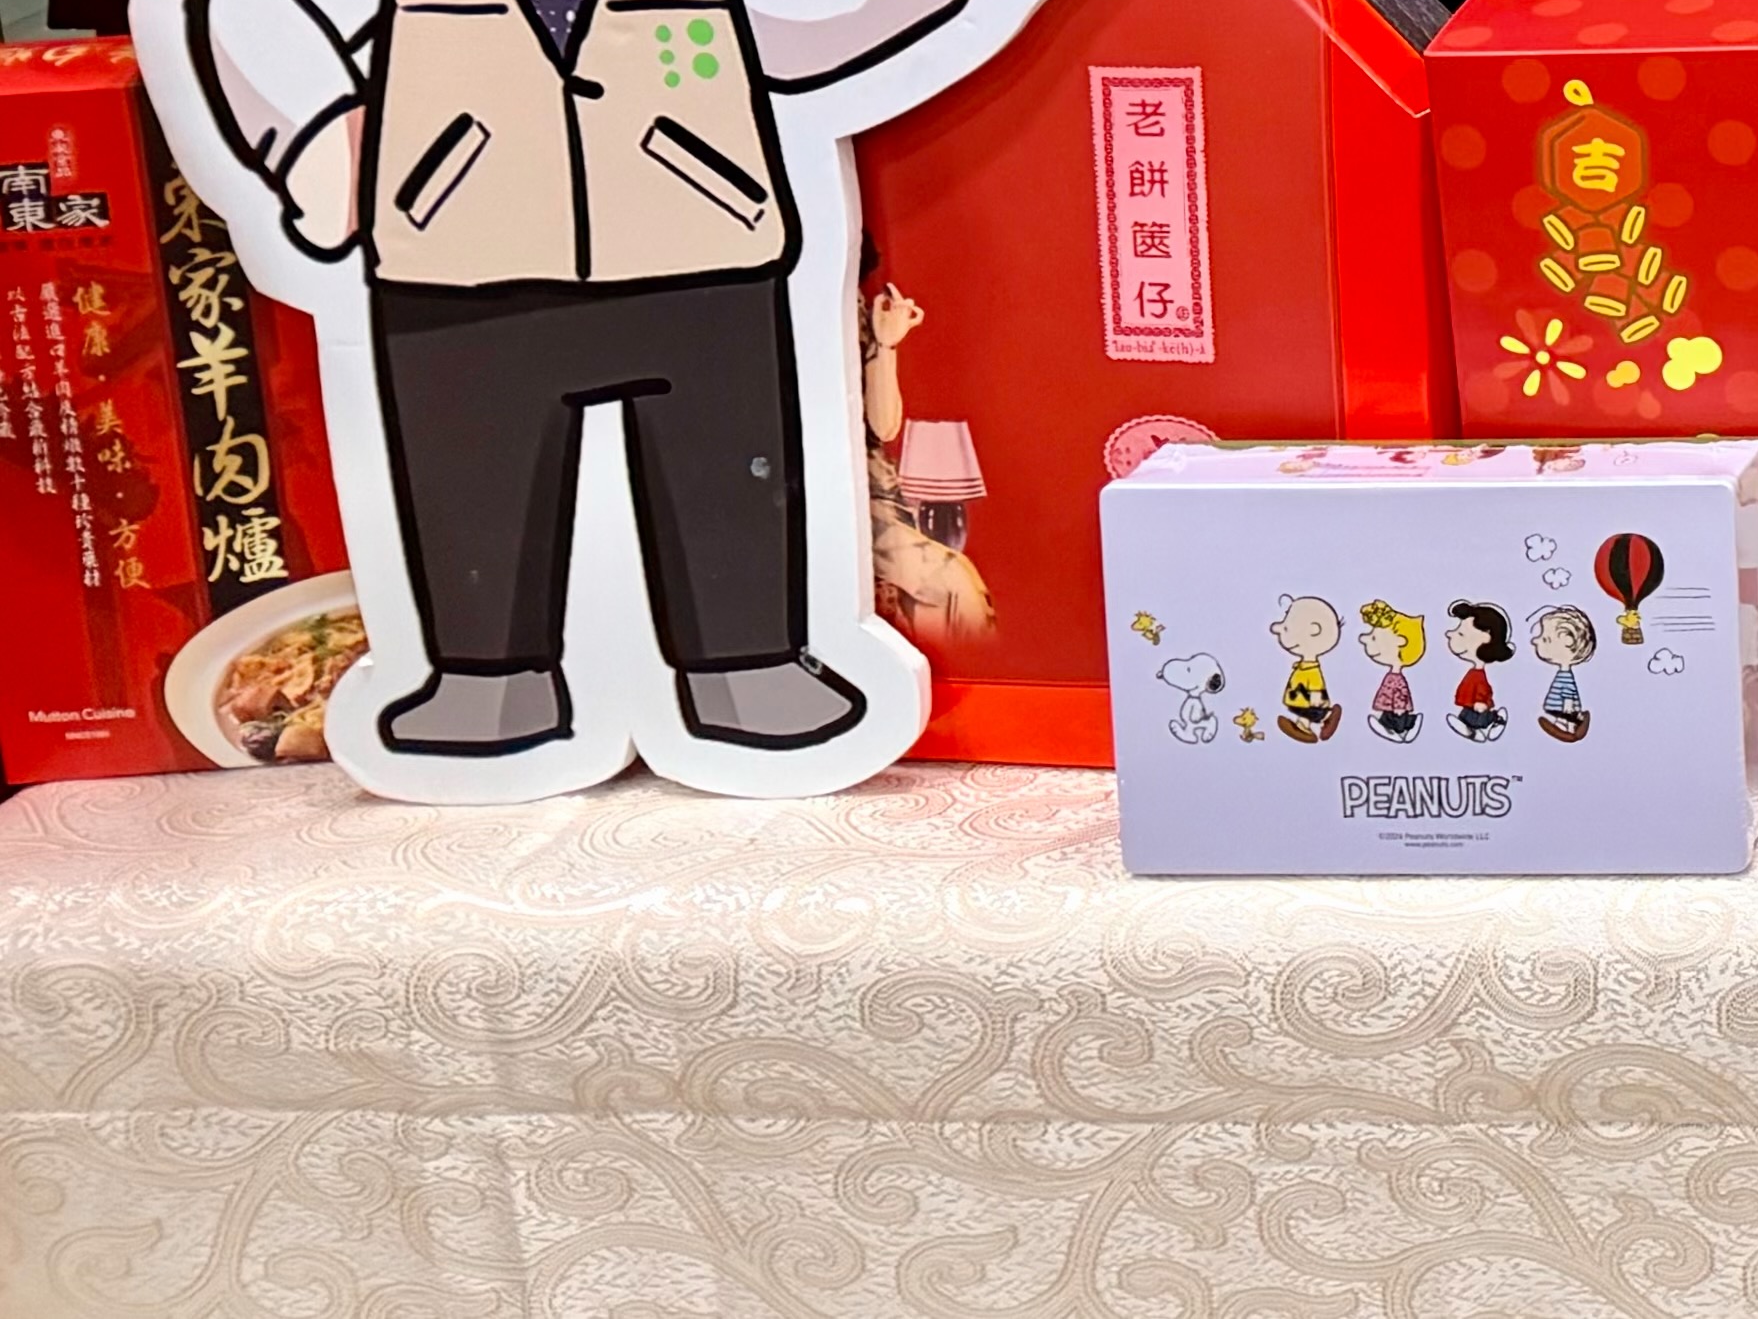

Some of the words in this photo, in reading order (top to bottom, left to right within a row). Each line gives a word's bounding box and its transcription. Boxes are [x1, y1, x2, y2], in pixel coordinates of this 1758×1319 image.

[1570, 135, 1626, 195] 吉
[6, 194, 110, 233] 東家
[28, 709, 81, 723] Mutton
[81, 707, 137, 721] Cuisine
[1340, 774, 1513, 819] PEANUTS
